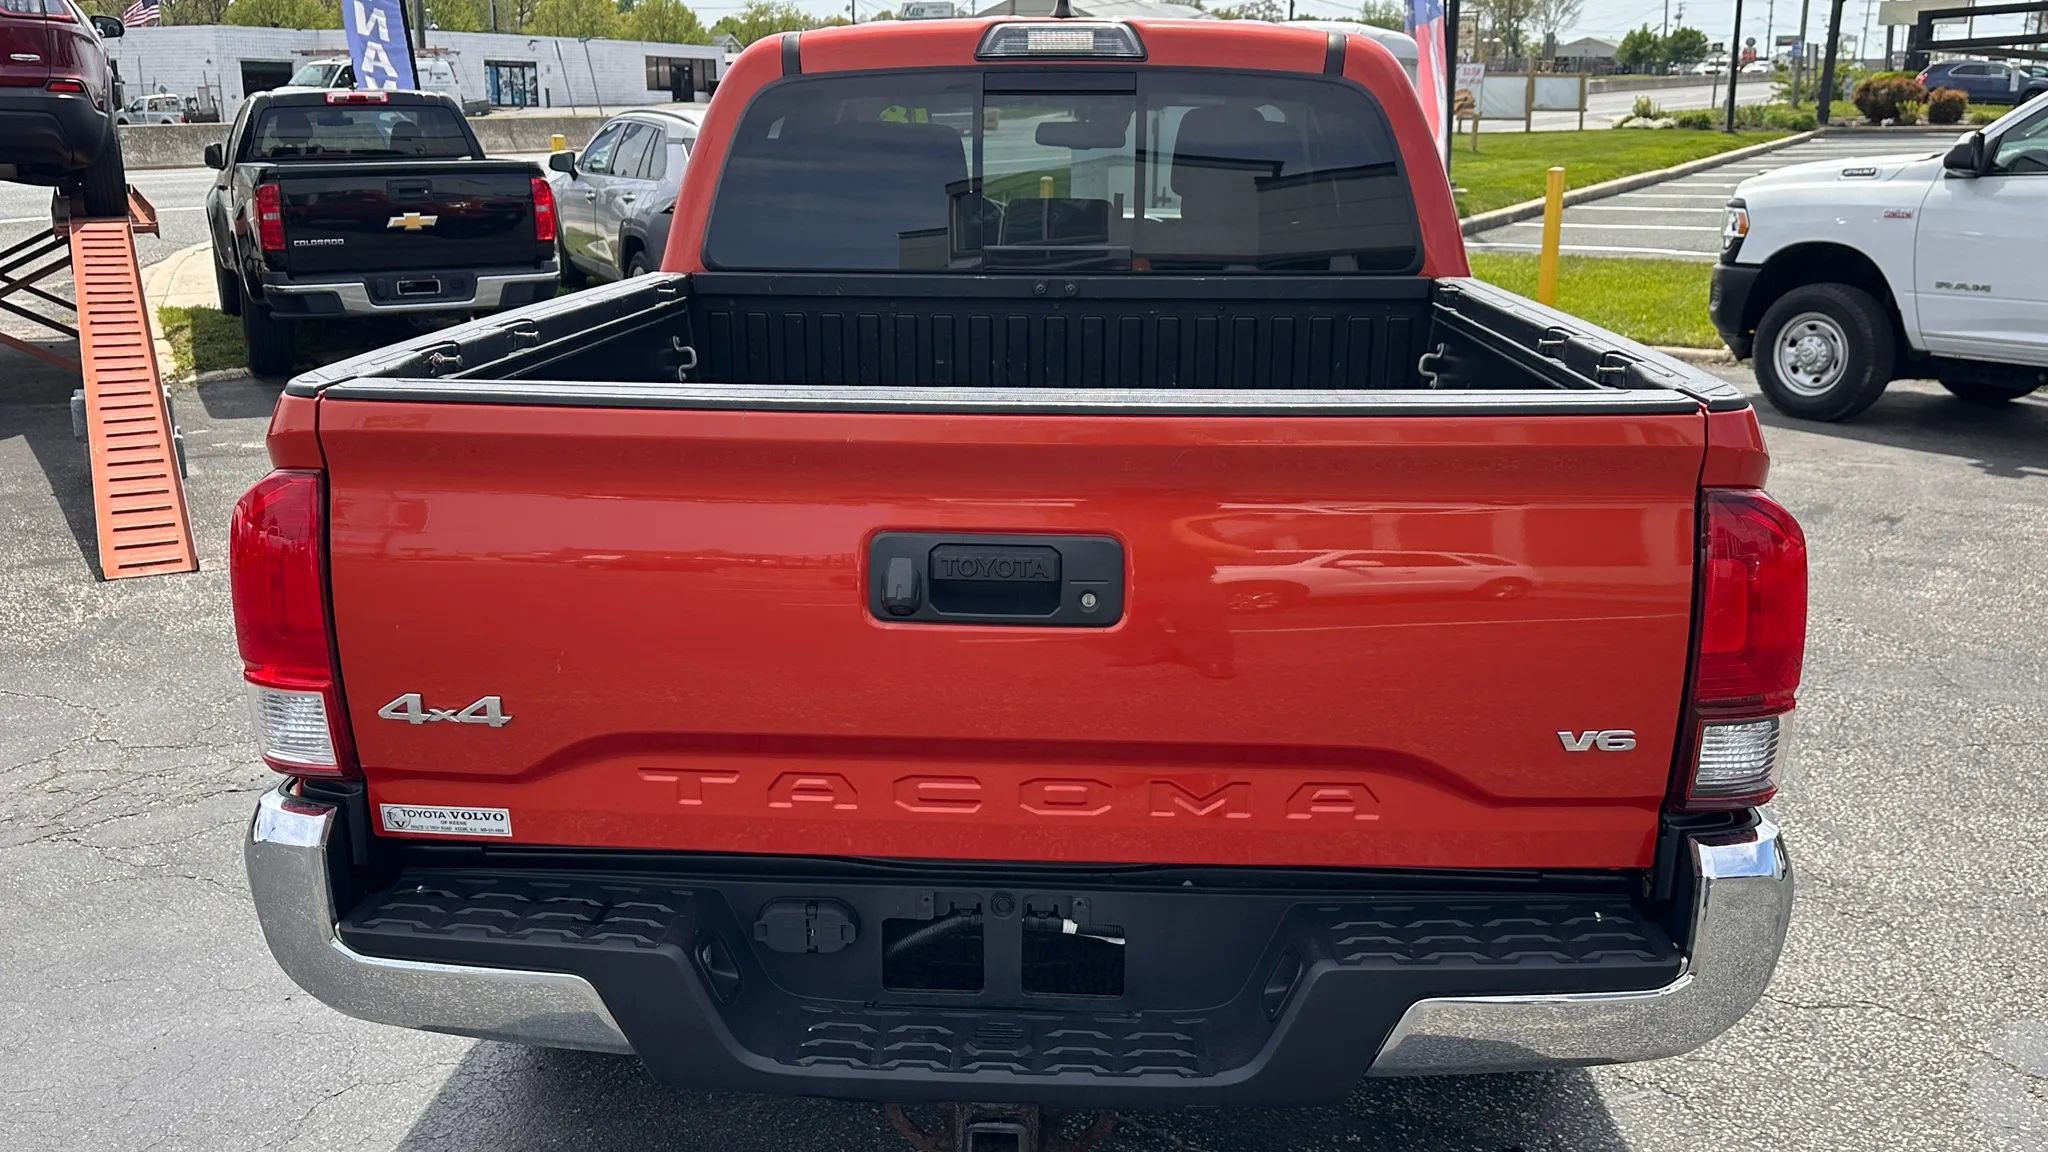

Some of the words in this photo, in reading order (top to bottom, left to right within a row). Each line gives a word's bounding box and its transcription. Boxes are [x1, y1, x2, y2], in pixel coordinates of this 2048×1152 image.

[293, 238, 345, 247] COLORADO
[940, 557, 1049, 579] TOYOTA
[377, 693, 513, 728] 4x4
[1556, 729, 1637, 752] V6
[638, 767, 1380, 822] TACOMA
[400, 809, 446, 819] TOYOTA
[449, 811, 505, 821] VOLVO
